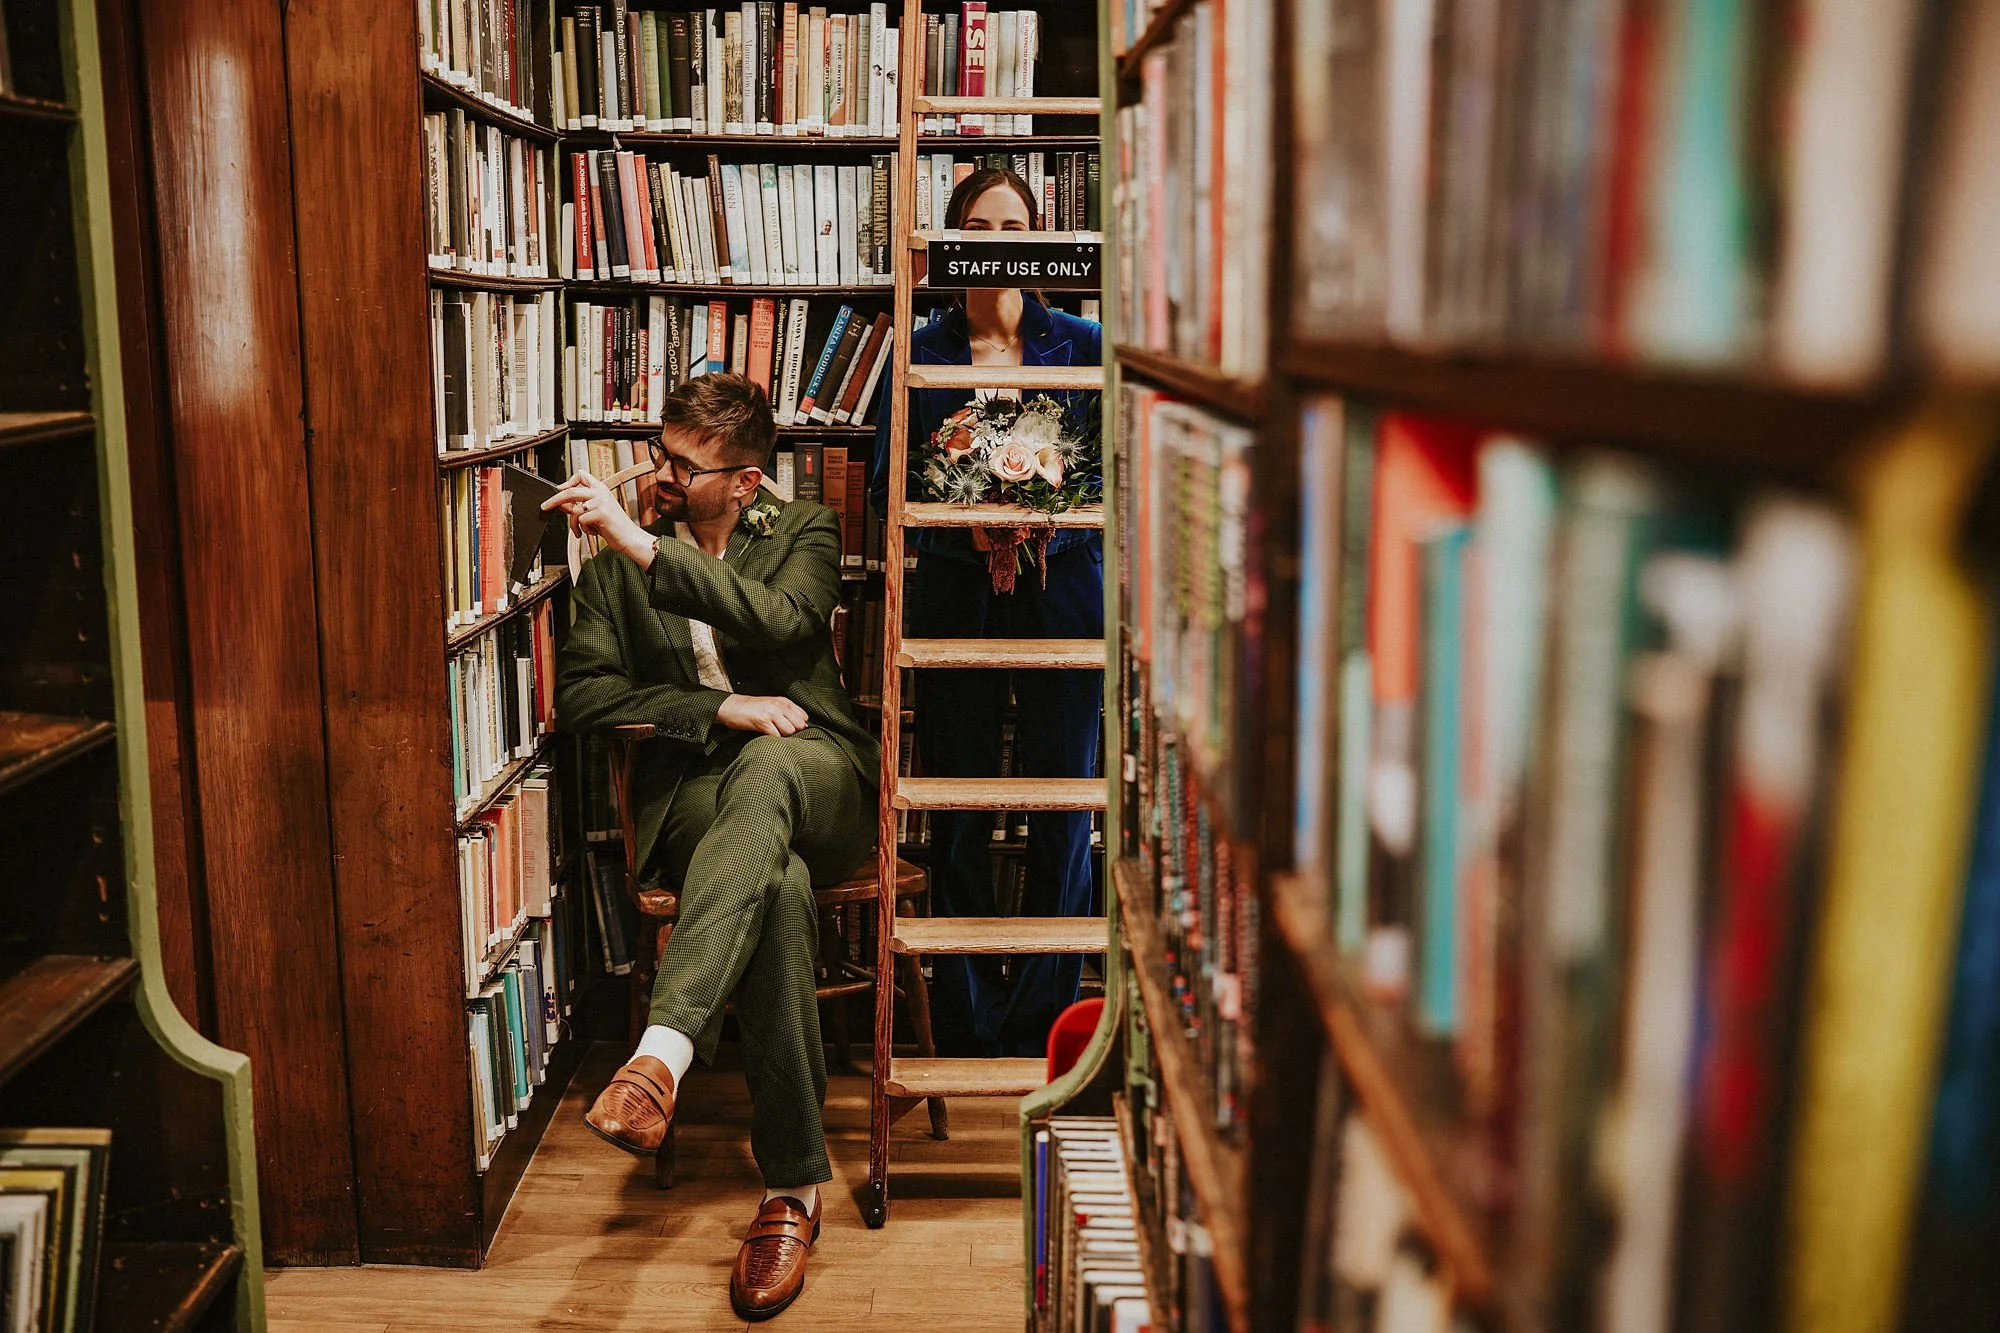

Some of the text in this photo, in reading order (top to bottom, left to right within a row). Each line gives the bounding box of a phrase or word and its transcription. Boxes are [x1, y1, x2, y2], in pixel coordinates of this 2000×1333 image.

[616, 6, 626, 81] THE OLD BOYS' NETWORK
[694, 15, 703, 58] the DONS
[966, 11, 985, 66] LSE
[745, 40, 753, 97] Maurice Bowra
[726, 173, 736, 209] PHINN
[1046, 183, 1055, 201] NOT
[1076, 161, 1085, 187] TIGER
[873, 169, 888, 246] MERCHANTS
[1076, 190, 1085, 200] BY
[1076, 201, 1085, 221] THE
[581, 232, 589, 257] Laughter
[948, 261, 1092, 276] STAFF USE ONLY
[668, 305, 680, 348] DAMAGED
[777, 303, 787, 337] Shopkeeper's
[794, 305, 804, 342] HANSON:
[640, 329, 648, 377] CHECKOUT
[667, 342, 679, 376] GOODS
[775, 337, 784, 361] WORLD
[812, 319, 845, 388] ANITA RODDICK
[787, 353, 798, 402] BIOGRAPHY
